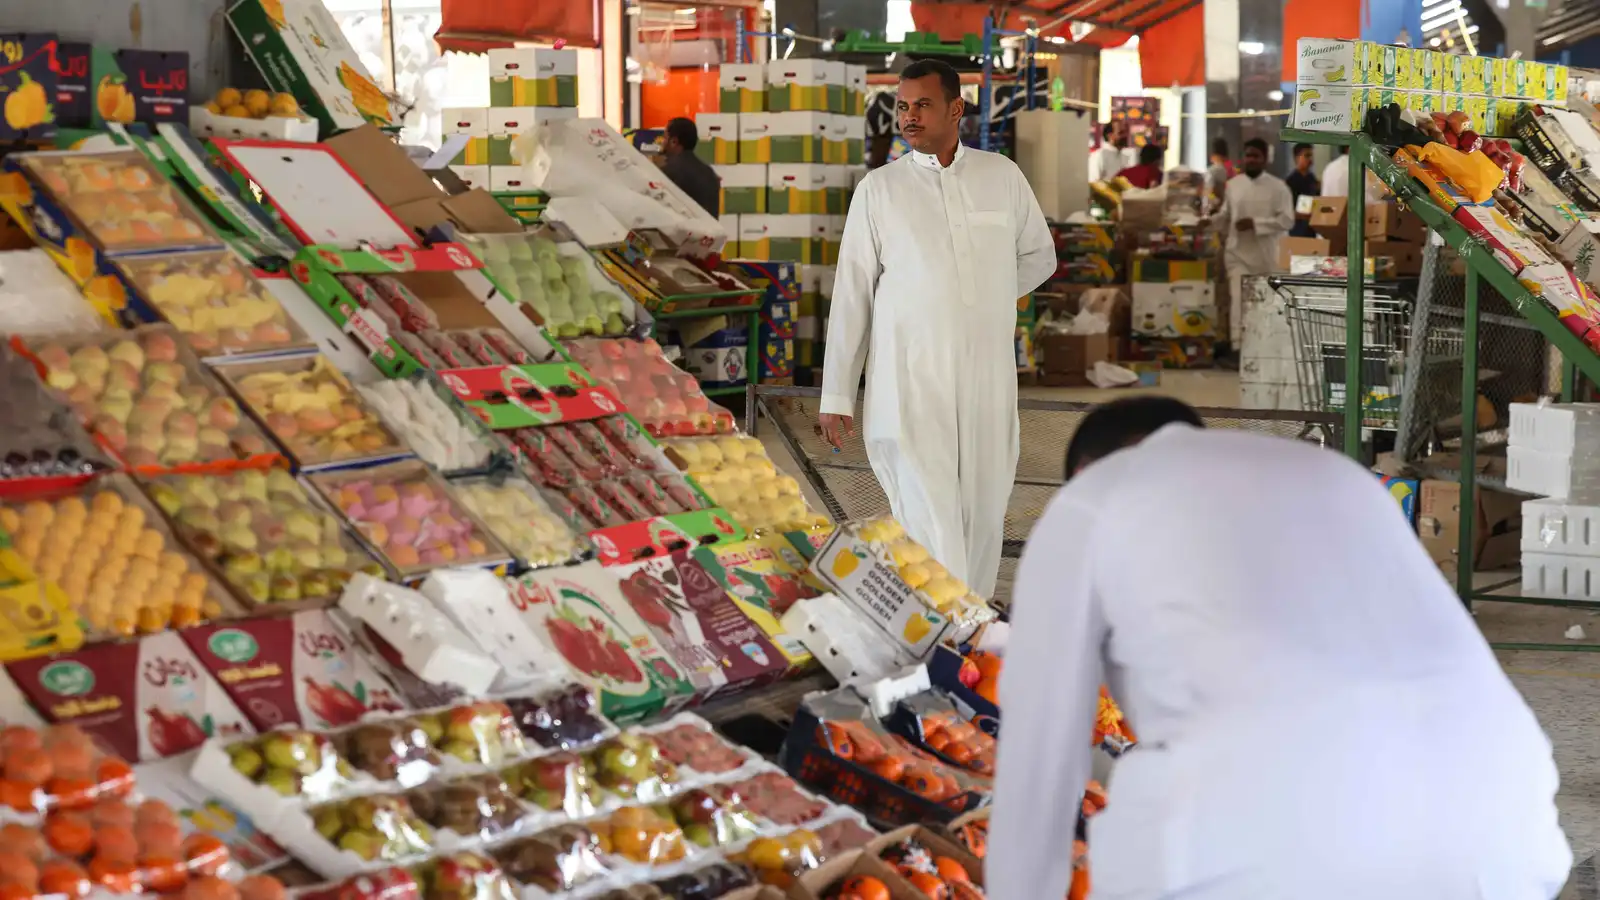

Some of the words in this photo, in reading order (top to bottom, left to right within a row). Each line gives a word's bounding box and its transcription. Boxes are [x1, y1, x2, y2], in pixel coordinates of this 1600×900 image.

[1301, 43, 1345, 58] Bananas
[1301, 113, 1344, 127] Bananas
[861, 578, 899, 613] GOLDEN
[868, 570, 904, 604] GOLDEN
[874, 562, 911, 597] GOLDEN
[855, 587, 892, 621] GOLDEN
